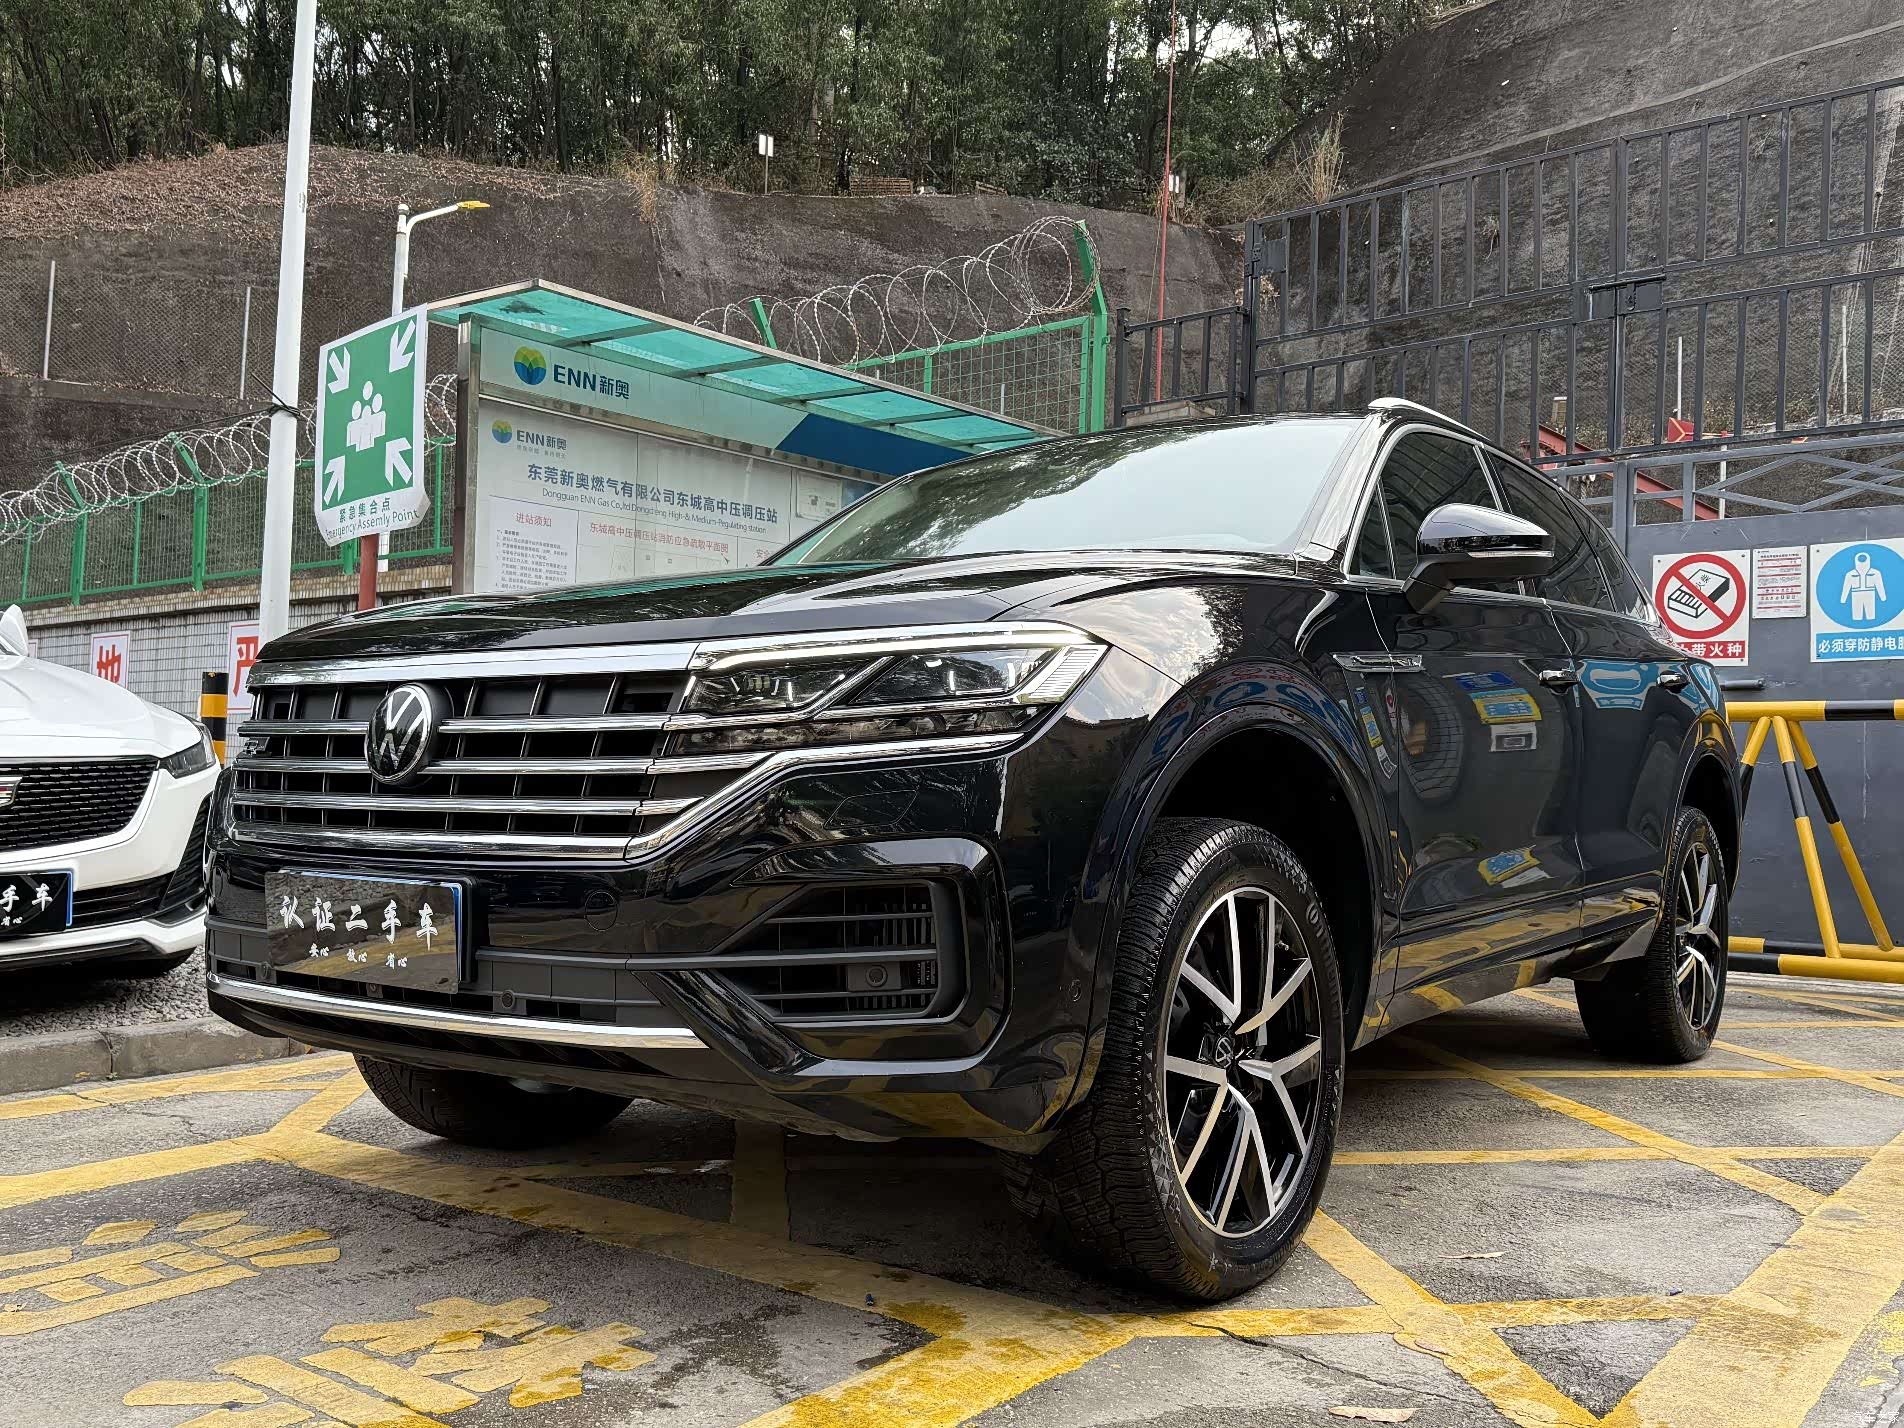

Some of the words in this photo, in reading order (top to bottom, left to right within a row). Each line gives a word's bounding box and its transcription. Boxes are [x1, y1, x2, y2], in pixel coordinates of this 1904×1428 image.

[527, 463, 778, 524] 东莞新奥燃气有限公司东城高中压调压站
[542, 487, 579, 502] Dongguan
[580, 494, 596, 505] ENN
[339, 497, 391, 523] 紧急集合点
[392, 509, 420, 523] Point
[516, 512, 552, 527] 进站须知
[279, 895, 439, 951] 认证二手车
